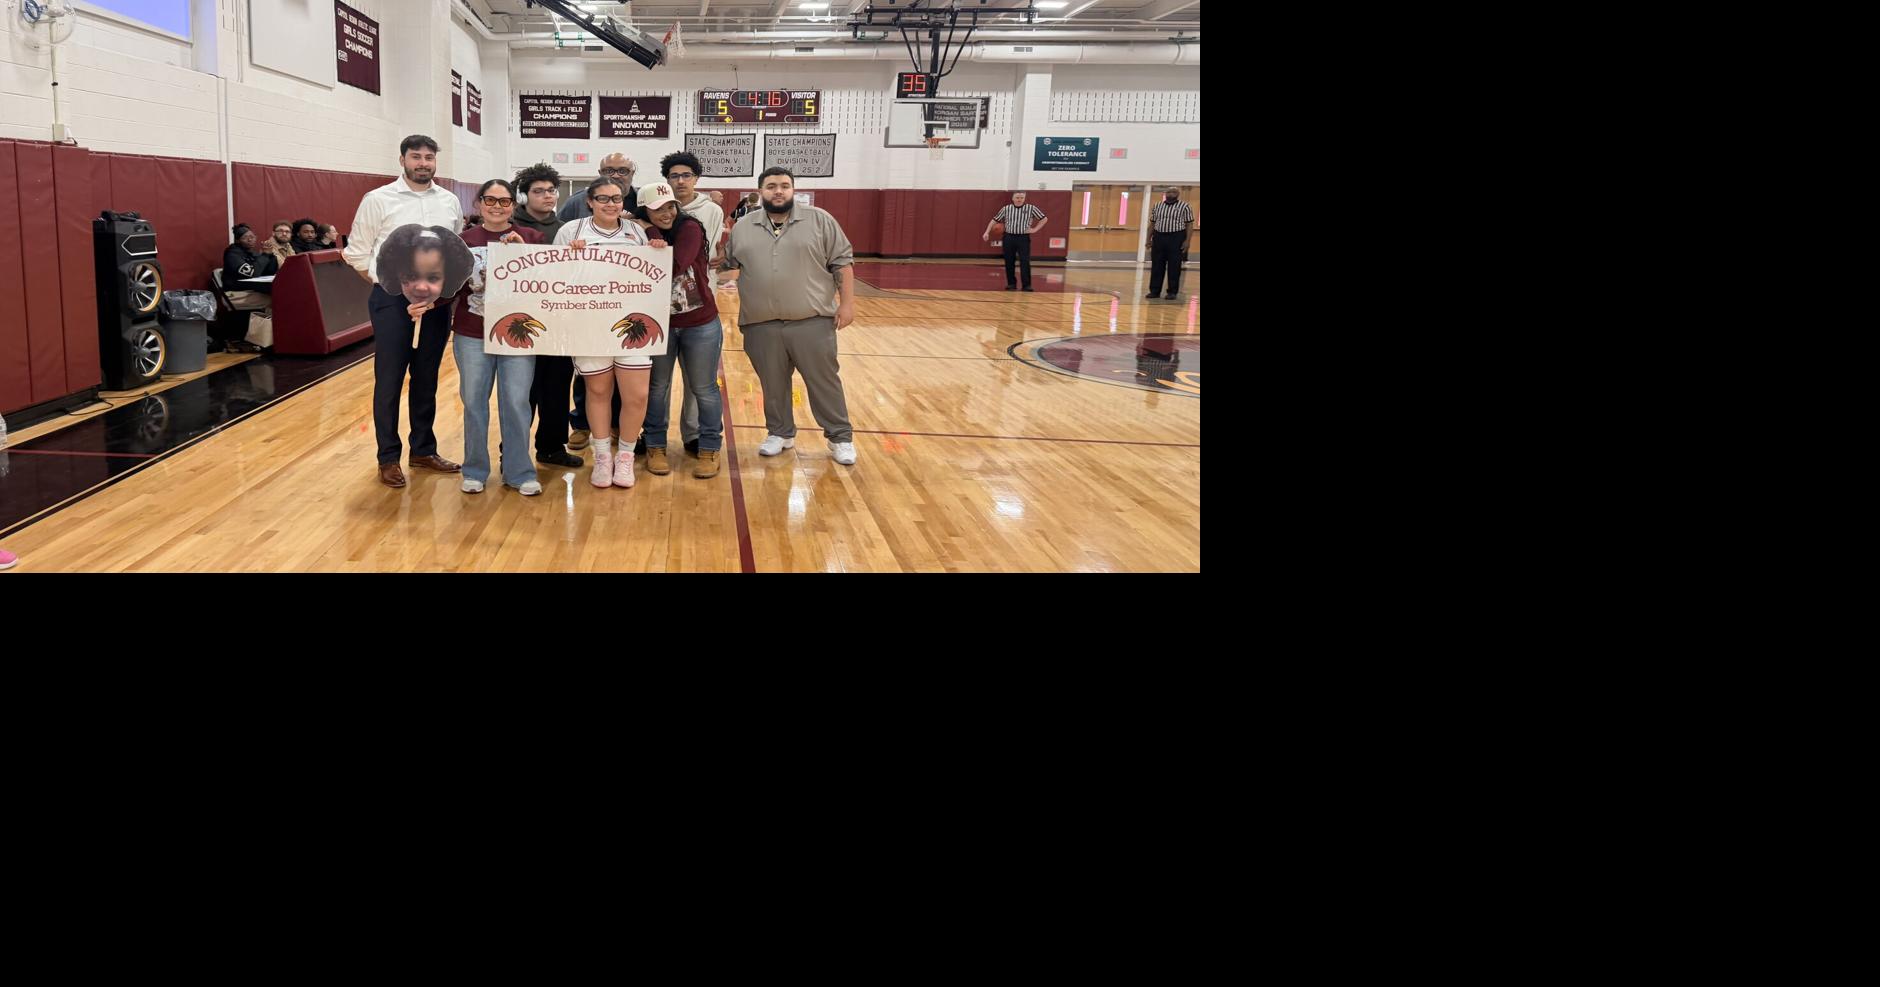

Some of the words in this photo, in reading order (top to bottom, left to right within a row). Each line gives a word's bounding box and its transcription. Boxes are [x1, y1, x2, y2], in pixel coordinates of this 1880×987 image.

[345, 39, 373, 60] CHAMPIONS
[902, 75, 926, 92] 35
[718, 100, 728, 114] 5
[805, 100, 814, 114] 5
[689, 138, 709, 146] STATE
[712, 138, 750, 146] CHAMPIONS
[494, 248, 667, 284] CONGRATULATIONS!
[512, 280, 549, 293] 1000
[552, 282, 606, 294] Career
[608, 281, 652, 294] Points
[541, 300, 587, 312] Symber
[589, 301, 623, 310] Sutton
